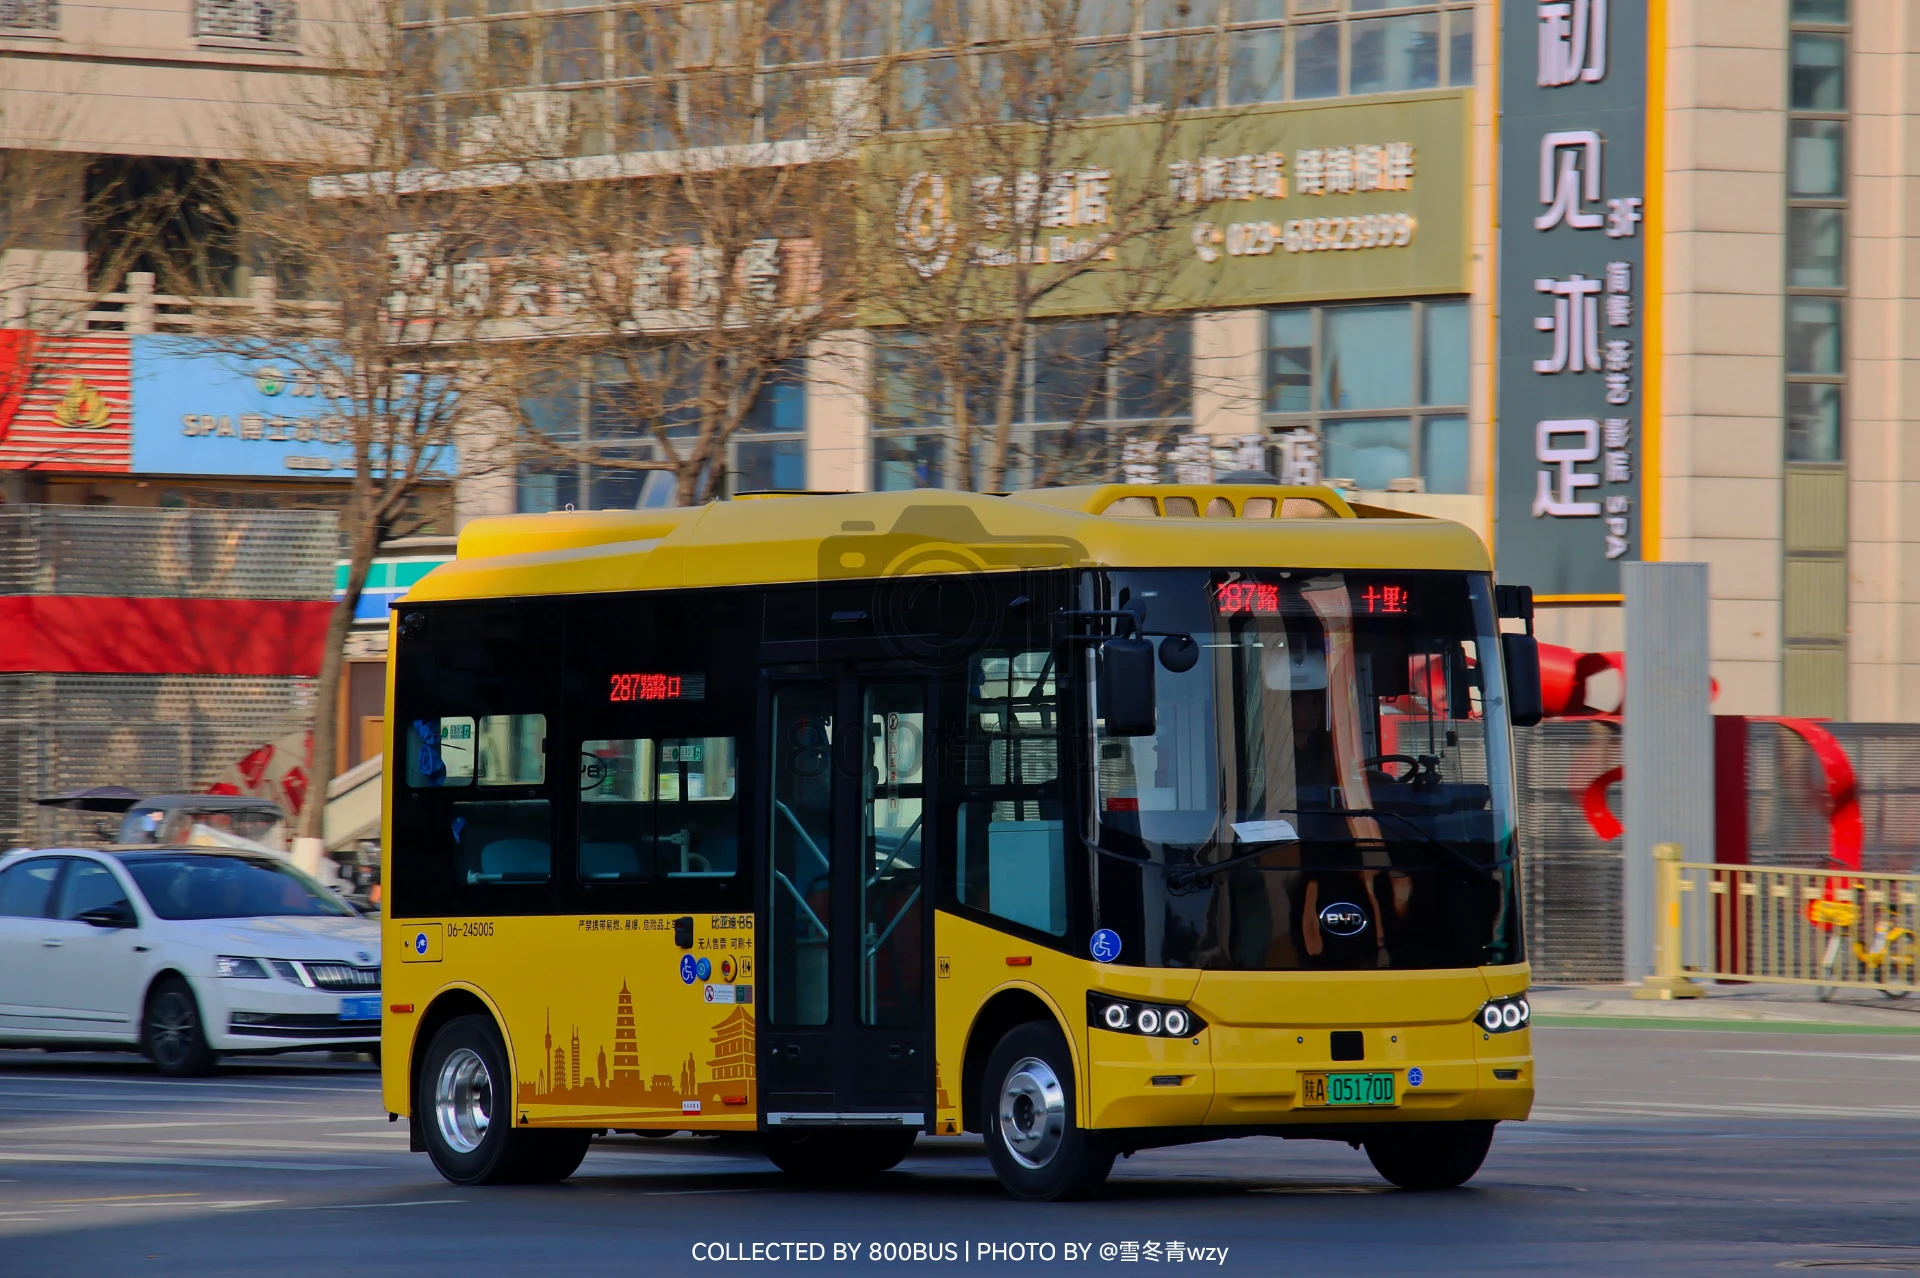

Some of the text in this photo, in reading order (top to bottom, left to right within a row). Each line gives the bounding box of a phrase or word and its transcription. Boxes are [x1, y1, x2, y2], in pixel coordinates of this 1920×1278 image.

[1226, 212, 1416, 256] 029-68323999
[1607, 198, 1641, 237] 3F
[1605, 496, 1628, 559] SPA
[1217, 582, 1279, 613] 287路
[447, 922, 494, 937] 06-245005
[1326, 913, 1362, 925] BYD
